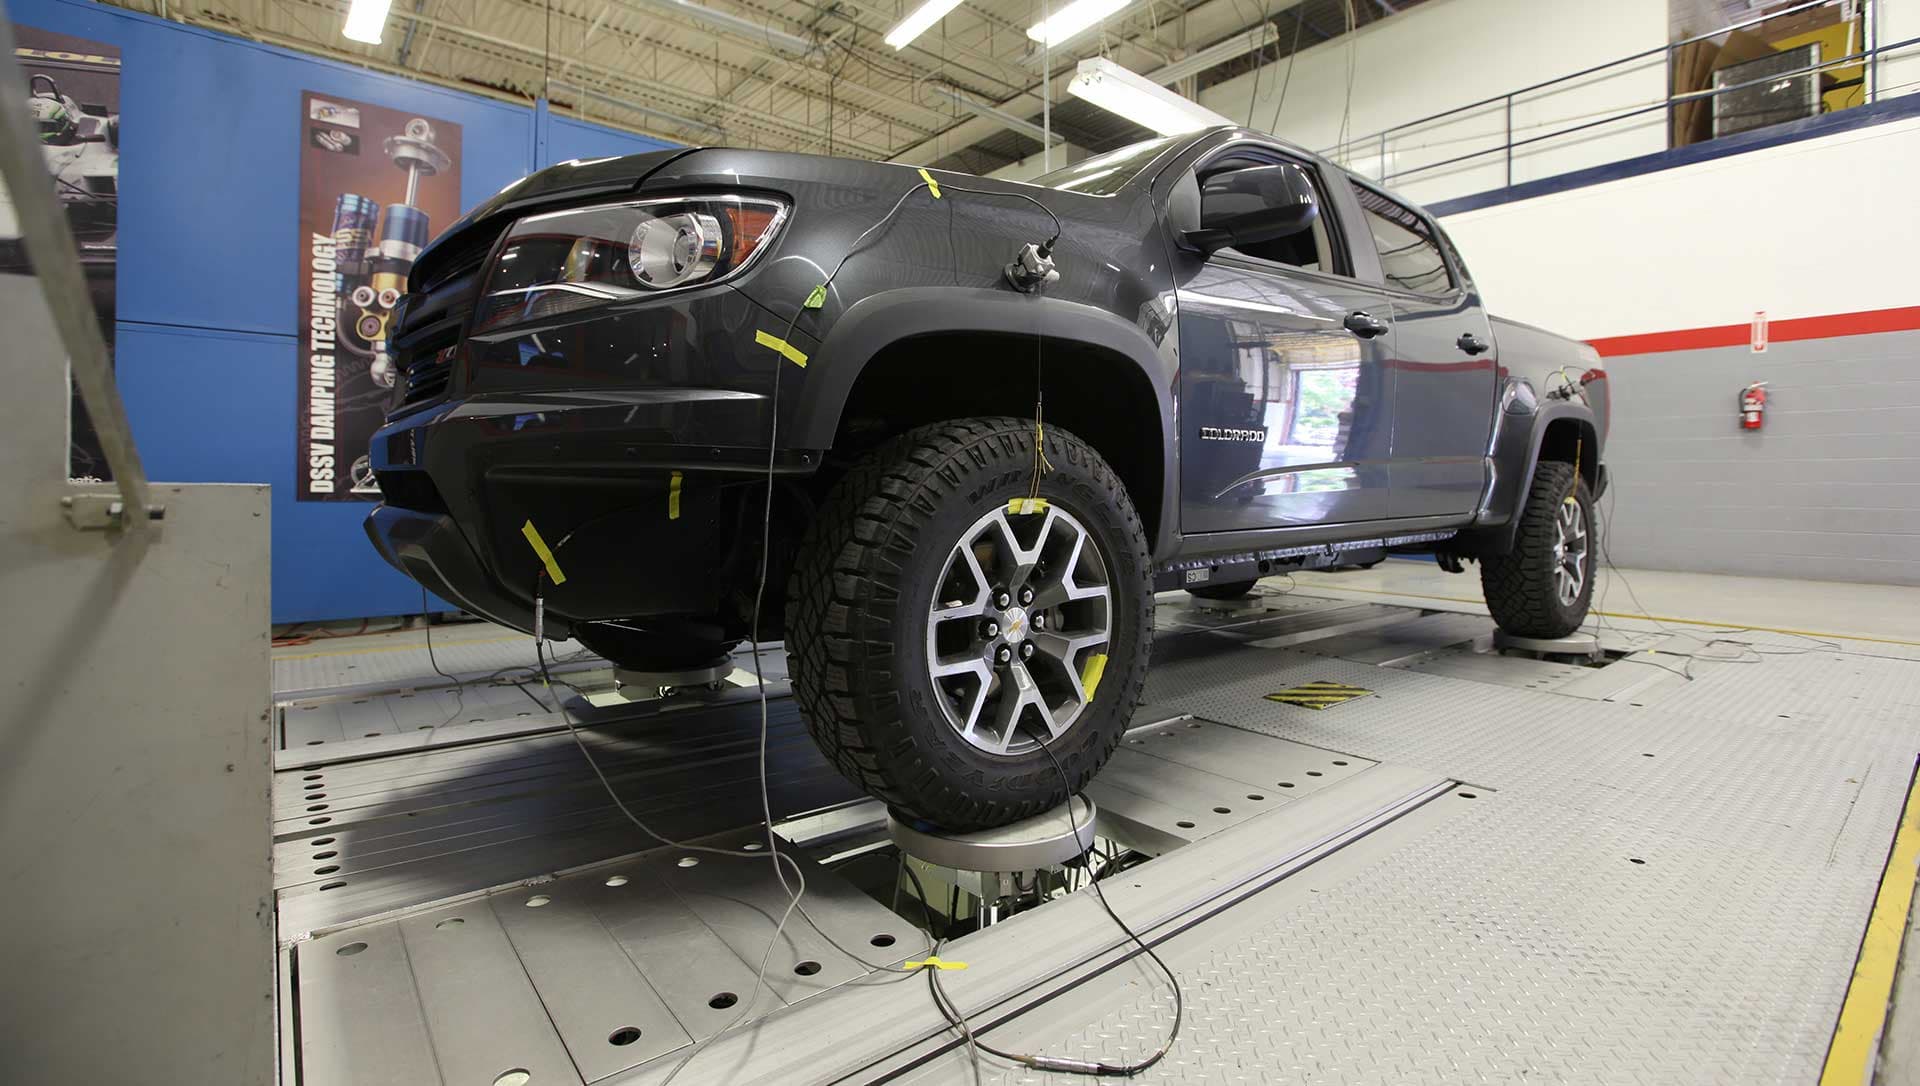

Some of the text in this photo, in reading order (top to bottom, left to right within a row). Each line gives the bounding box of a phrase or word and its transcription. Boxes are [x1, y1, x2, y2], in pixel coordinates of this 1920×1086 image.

[309, 231, 337, 493] DSSV DAMPING TECHNOLOGY
[1201, 426, 1265, 442] COLORADO
